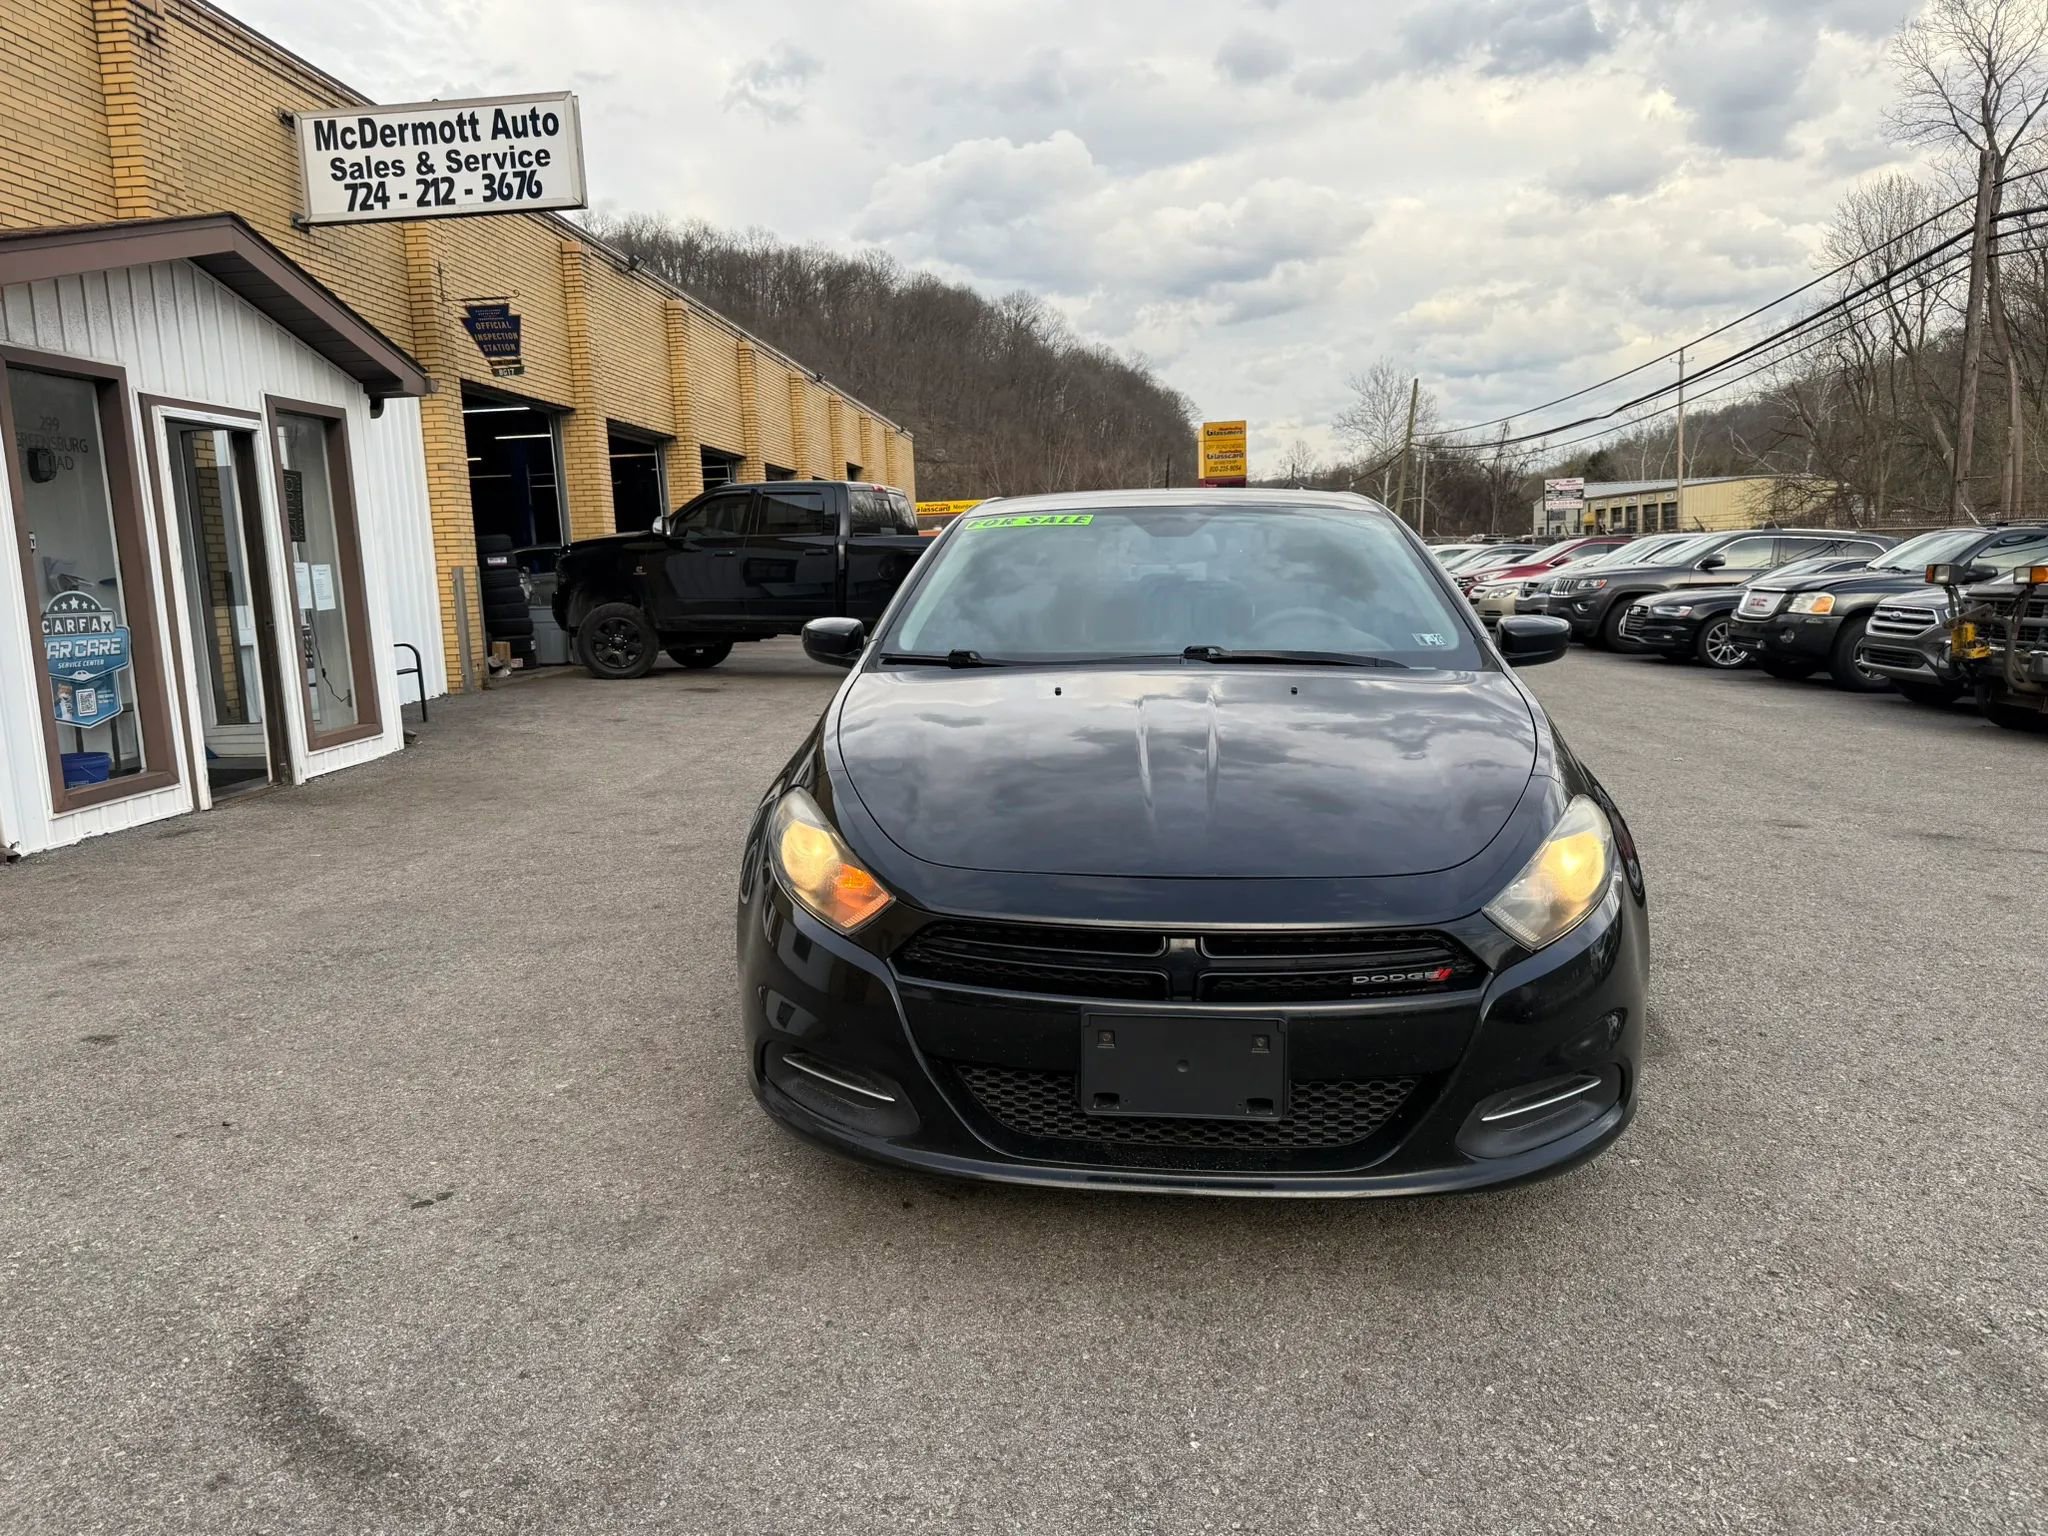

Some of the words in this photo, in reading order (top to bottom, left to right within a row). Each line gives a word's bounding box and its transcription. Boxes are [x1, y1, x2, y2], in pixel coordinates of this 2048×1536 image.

[313, 110, 481, 151] McDermott
[491, 106, 559, 140] Auto
[330, 155, 406, 182] Sales
[416, 151, 437, 176] &
[446, 145, 551, 173] Service
[344, 181, 391, 212] 724
[416, 176, 456, 207] 212
[481, 169, 543, 203] 3676
[475, 321, 511, 330] OFFICIAL
[474, 332, 519, 342] INSPECTION
[482, 343, 517, 352] STATION
[39, 416, 60, 431] 299
[967, 518, 1013, 528] FOR
[1025, 515, 1091, 525] SALE
[41, 618, 114, 634] CARFAX
[44, 640, 72, 660] AR
[74, 637, 121, 658] CARE
[57, 660, 82, 669] SERVICE
[82, 658, 105, 667] CENTER
[1352, 971, 1440, 983] DODGE
